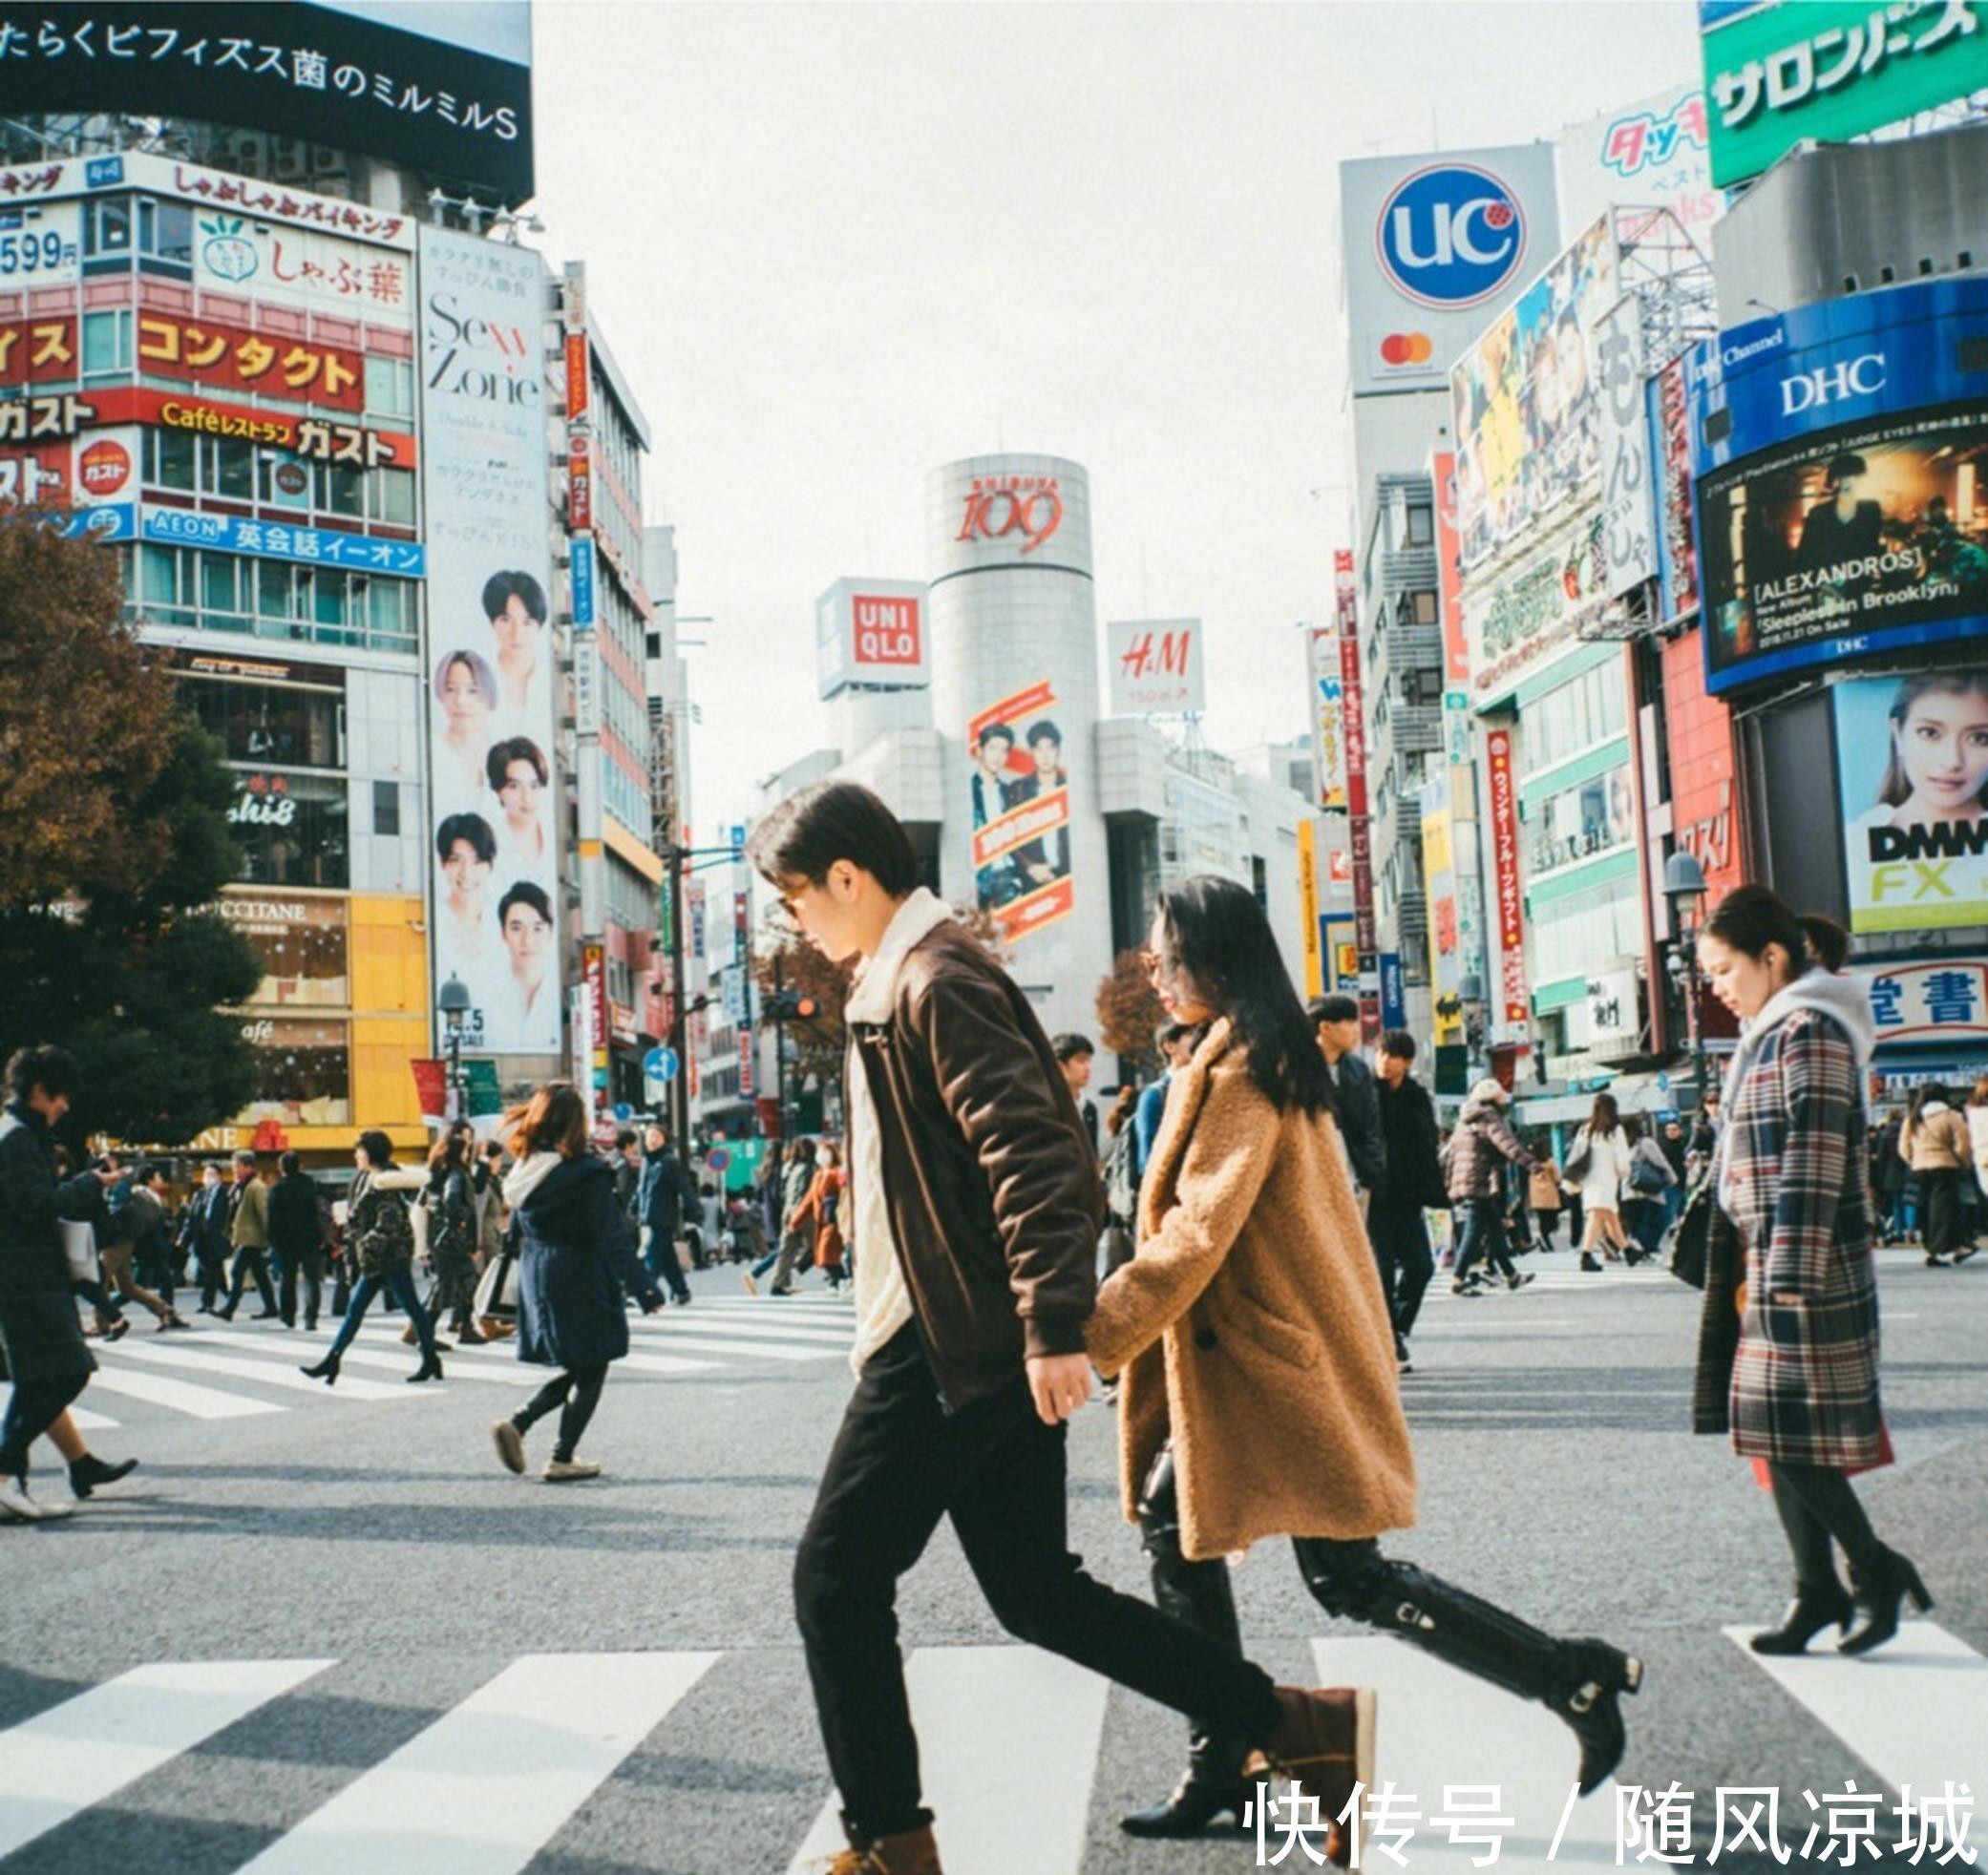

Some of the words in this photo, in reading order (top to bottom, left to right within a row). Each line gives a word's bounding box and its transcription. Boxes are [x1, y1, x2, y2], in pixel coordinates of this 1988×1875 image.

[0, 22, 518, 140] たらくビフィズス菌のミルミルS
[1392, 198, 1512, 268] UC
[271, 239, 403, 304] しゃぶ葉
[139, 318, 356, 394] コンタクト
[1723, 326, 1785, 367] Channel
[429, 345, 539, 406] Zone
[1779, 352, 1888, 417] DHC
[298, 419, 394, 467] ガスト
[153, 512, 220, 537] AEON
[237, 522, 420, 570] 英会話イーオン
[955, 488, 1063, 553] 109
[1754, 547, 1923, 604] [ALEXANDROS]
[860, 602, 908, 629] UNI
[863, 632, 915, 661] QLO
[1868, 818, 1988, 863] DMM
[1871, 860, 1956, 903] FX
[241, 1019, 274, 1043] afé
